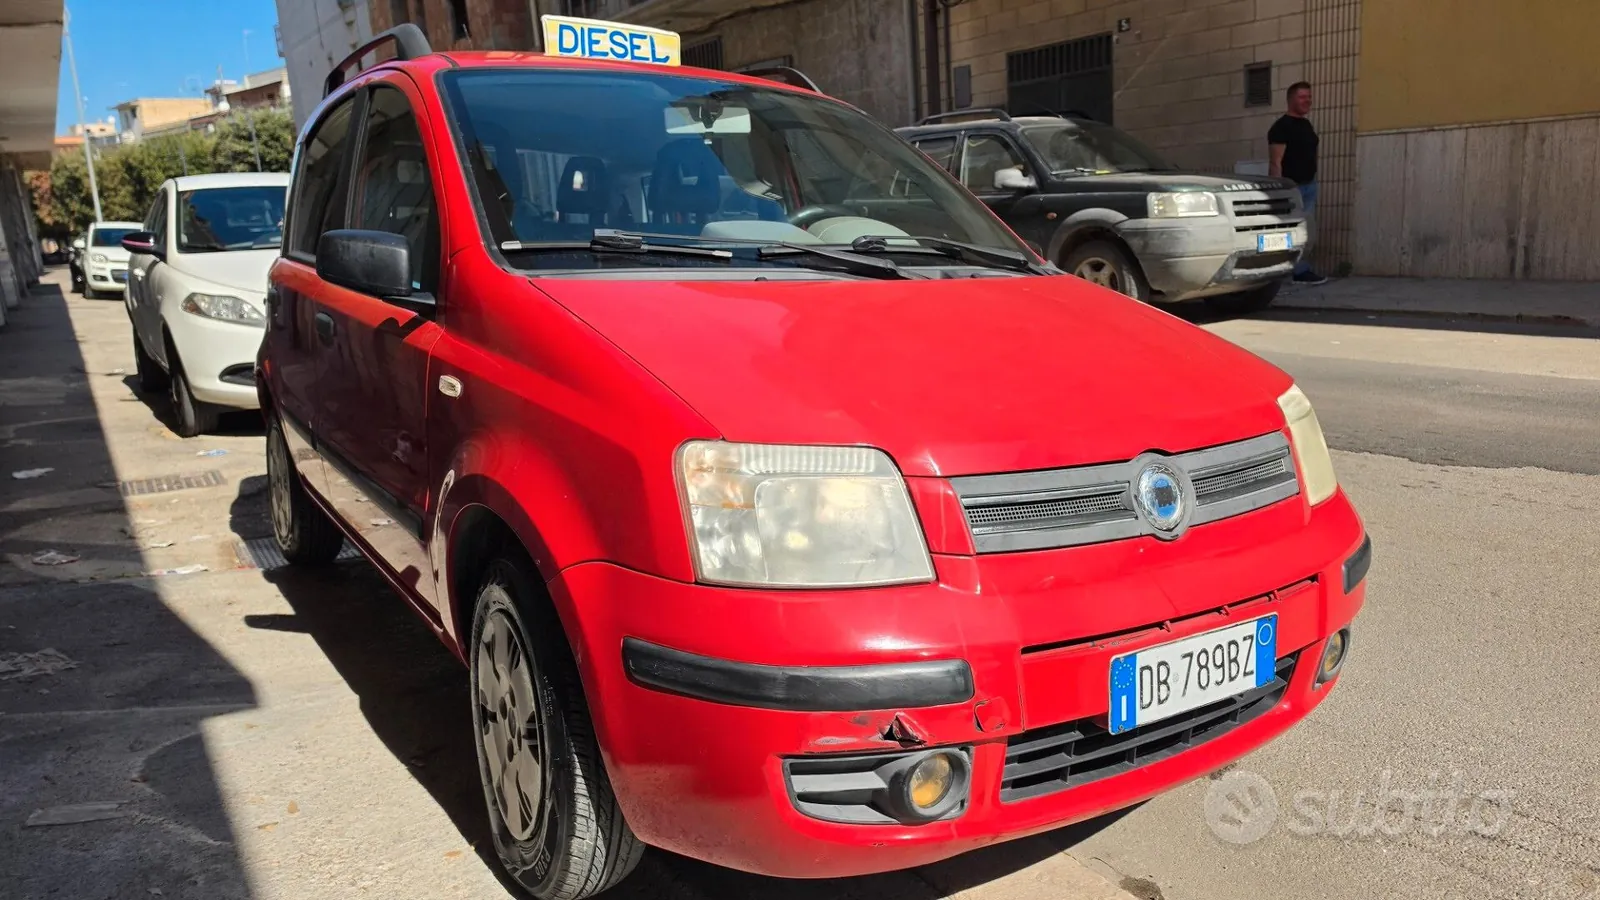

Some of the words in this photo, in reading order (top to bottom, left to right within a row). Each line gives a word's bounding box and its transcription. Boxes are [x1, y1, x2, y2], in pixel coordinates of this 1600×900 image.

[558, 24, 670, 63] DIESEL
[1139, 660, 1171, 710] DB
[1180, 634, 1255, 698] 789BZ
